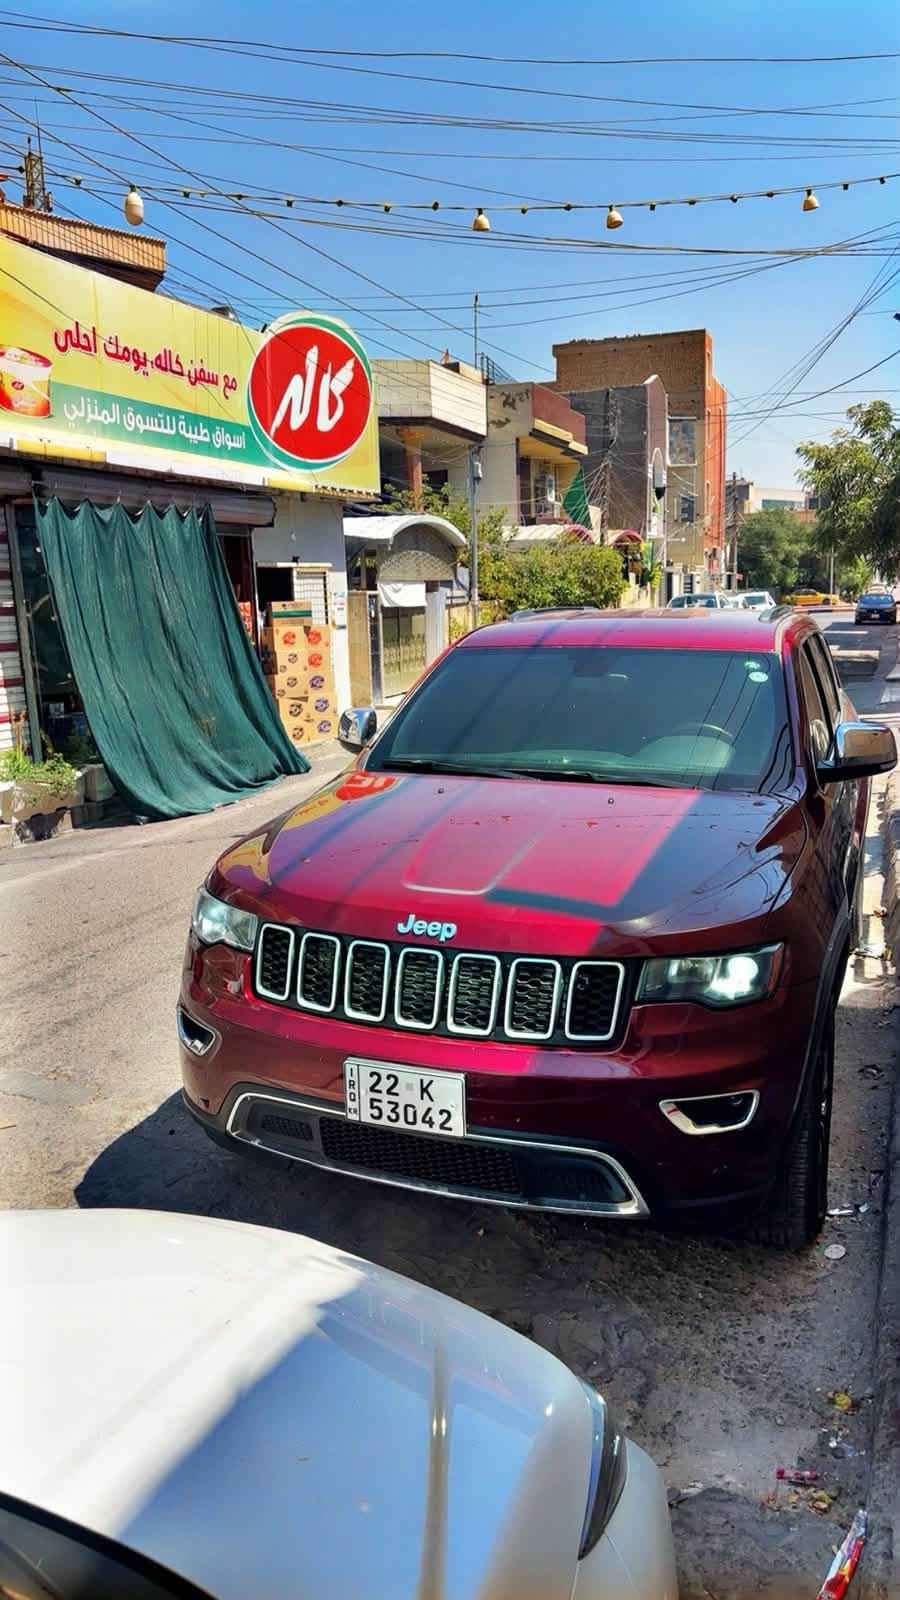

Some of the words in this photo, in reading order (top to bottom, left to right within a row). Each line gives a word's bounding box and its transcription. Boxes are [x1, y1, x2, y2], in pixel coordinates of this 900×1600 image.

[54, 320, 97, 353] احلى
[103, 335, 149, 377] يومك
[187, 359, 218, 386] سفن
[223, 374, 237, 400] مع
[63, 395, 120, 429] المنزلي
[122, 406, 177, 435] للتسوق
[178, 414, 210, 444] طيبة
[212, 425, 246, 450] اسواق
[397, 913, 457, 942] Jeep
[369, 1071, 399, 1096] 22
[420, 1078, 434, 1102] K
[369, 1098, 452, 1131] 53042
